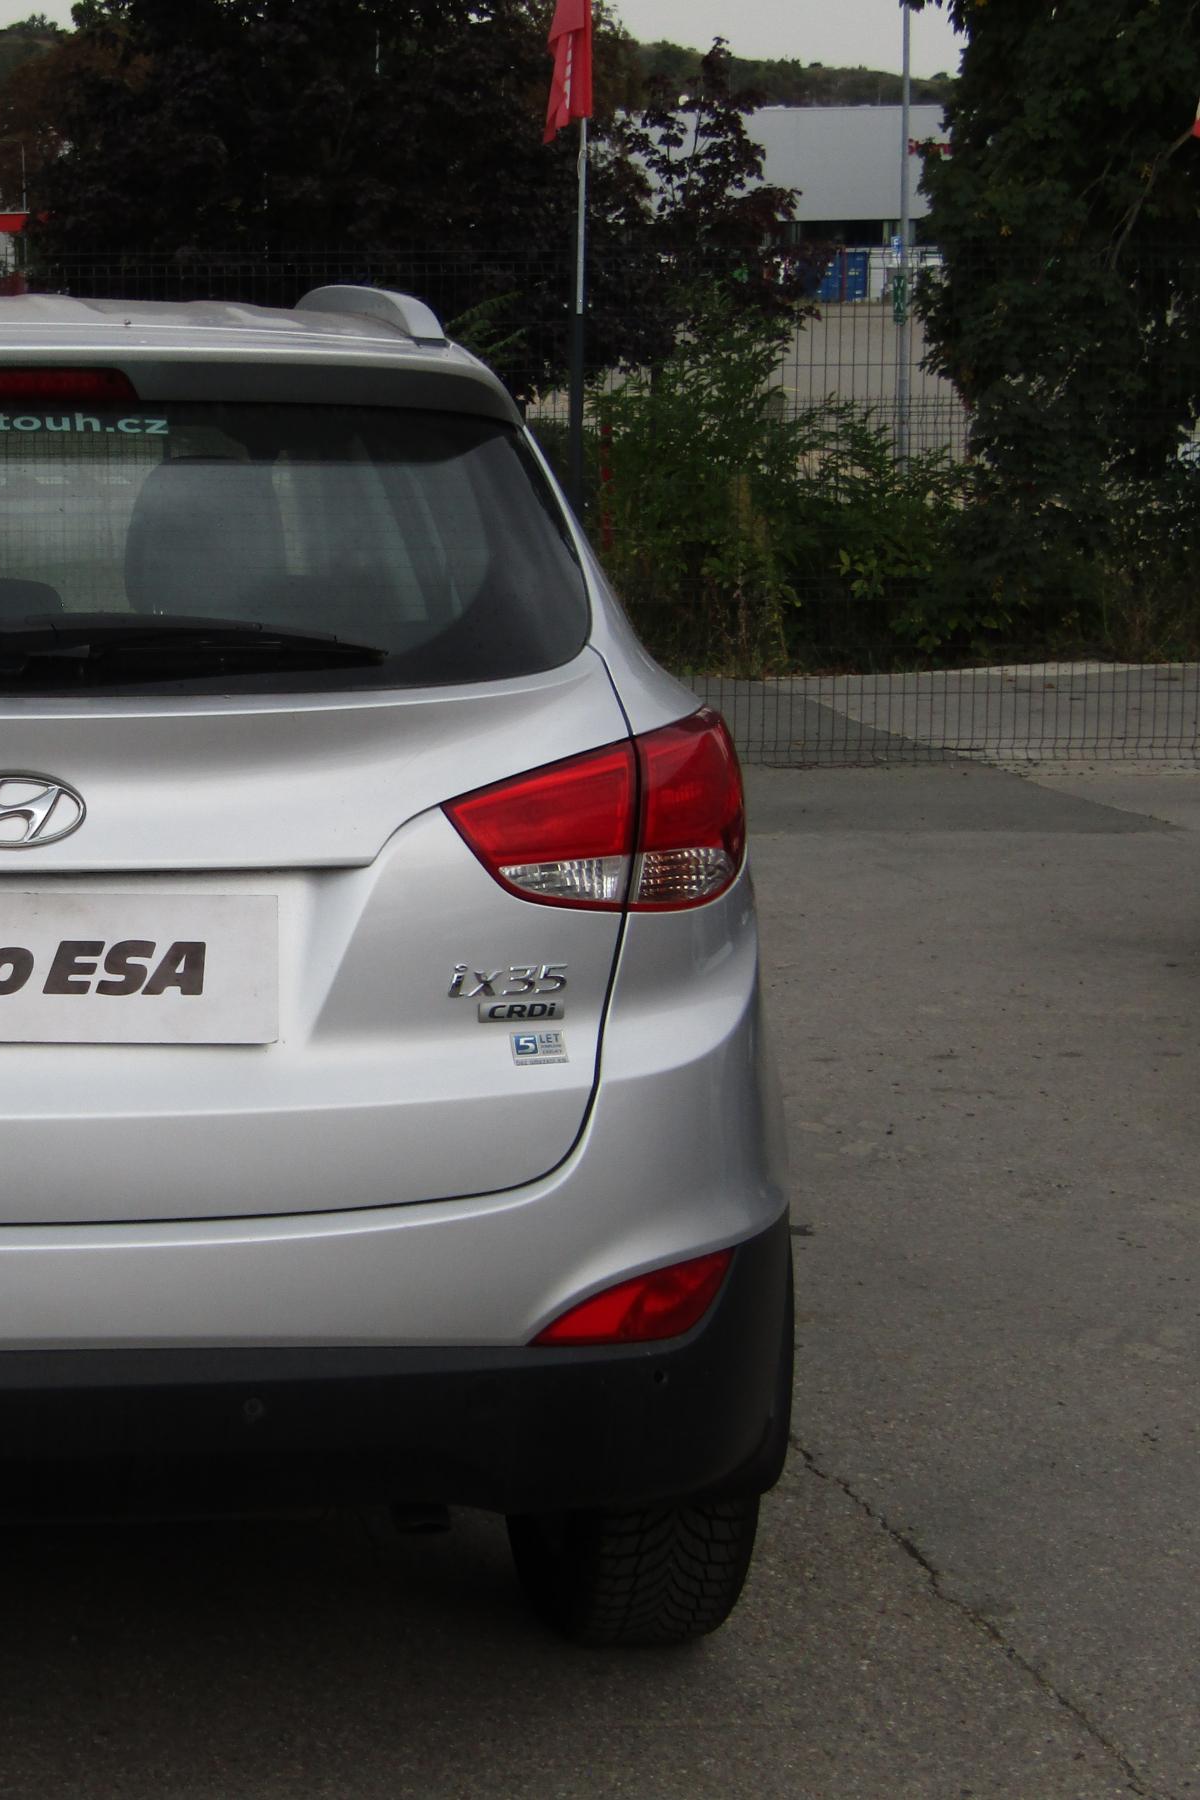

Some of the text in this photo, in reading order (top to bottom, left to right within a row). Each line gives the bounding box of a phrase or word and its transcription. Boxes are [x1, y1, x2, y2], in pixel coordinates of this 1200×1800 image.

[42, 939, 207, 997] ESA
[448, 963, 569, 998] ix35
[488, 1003, 556, 1019] CRDi
[517, 1033, 560, 1054] 5 LET
